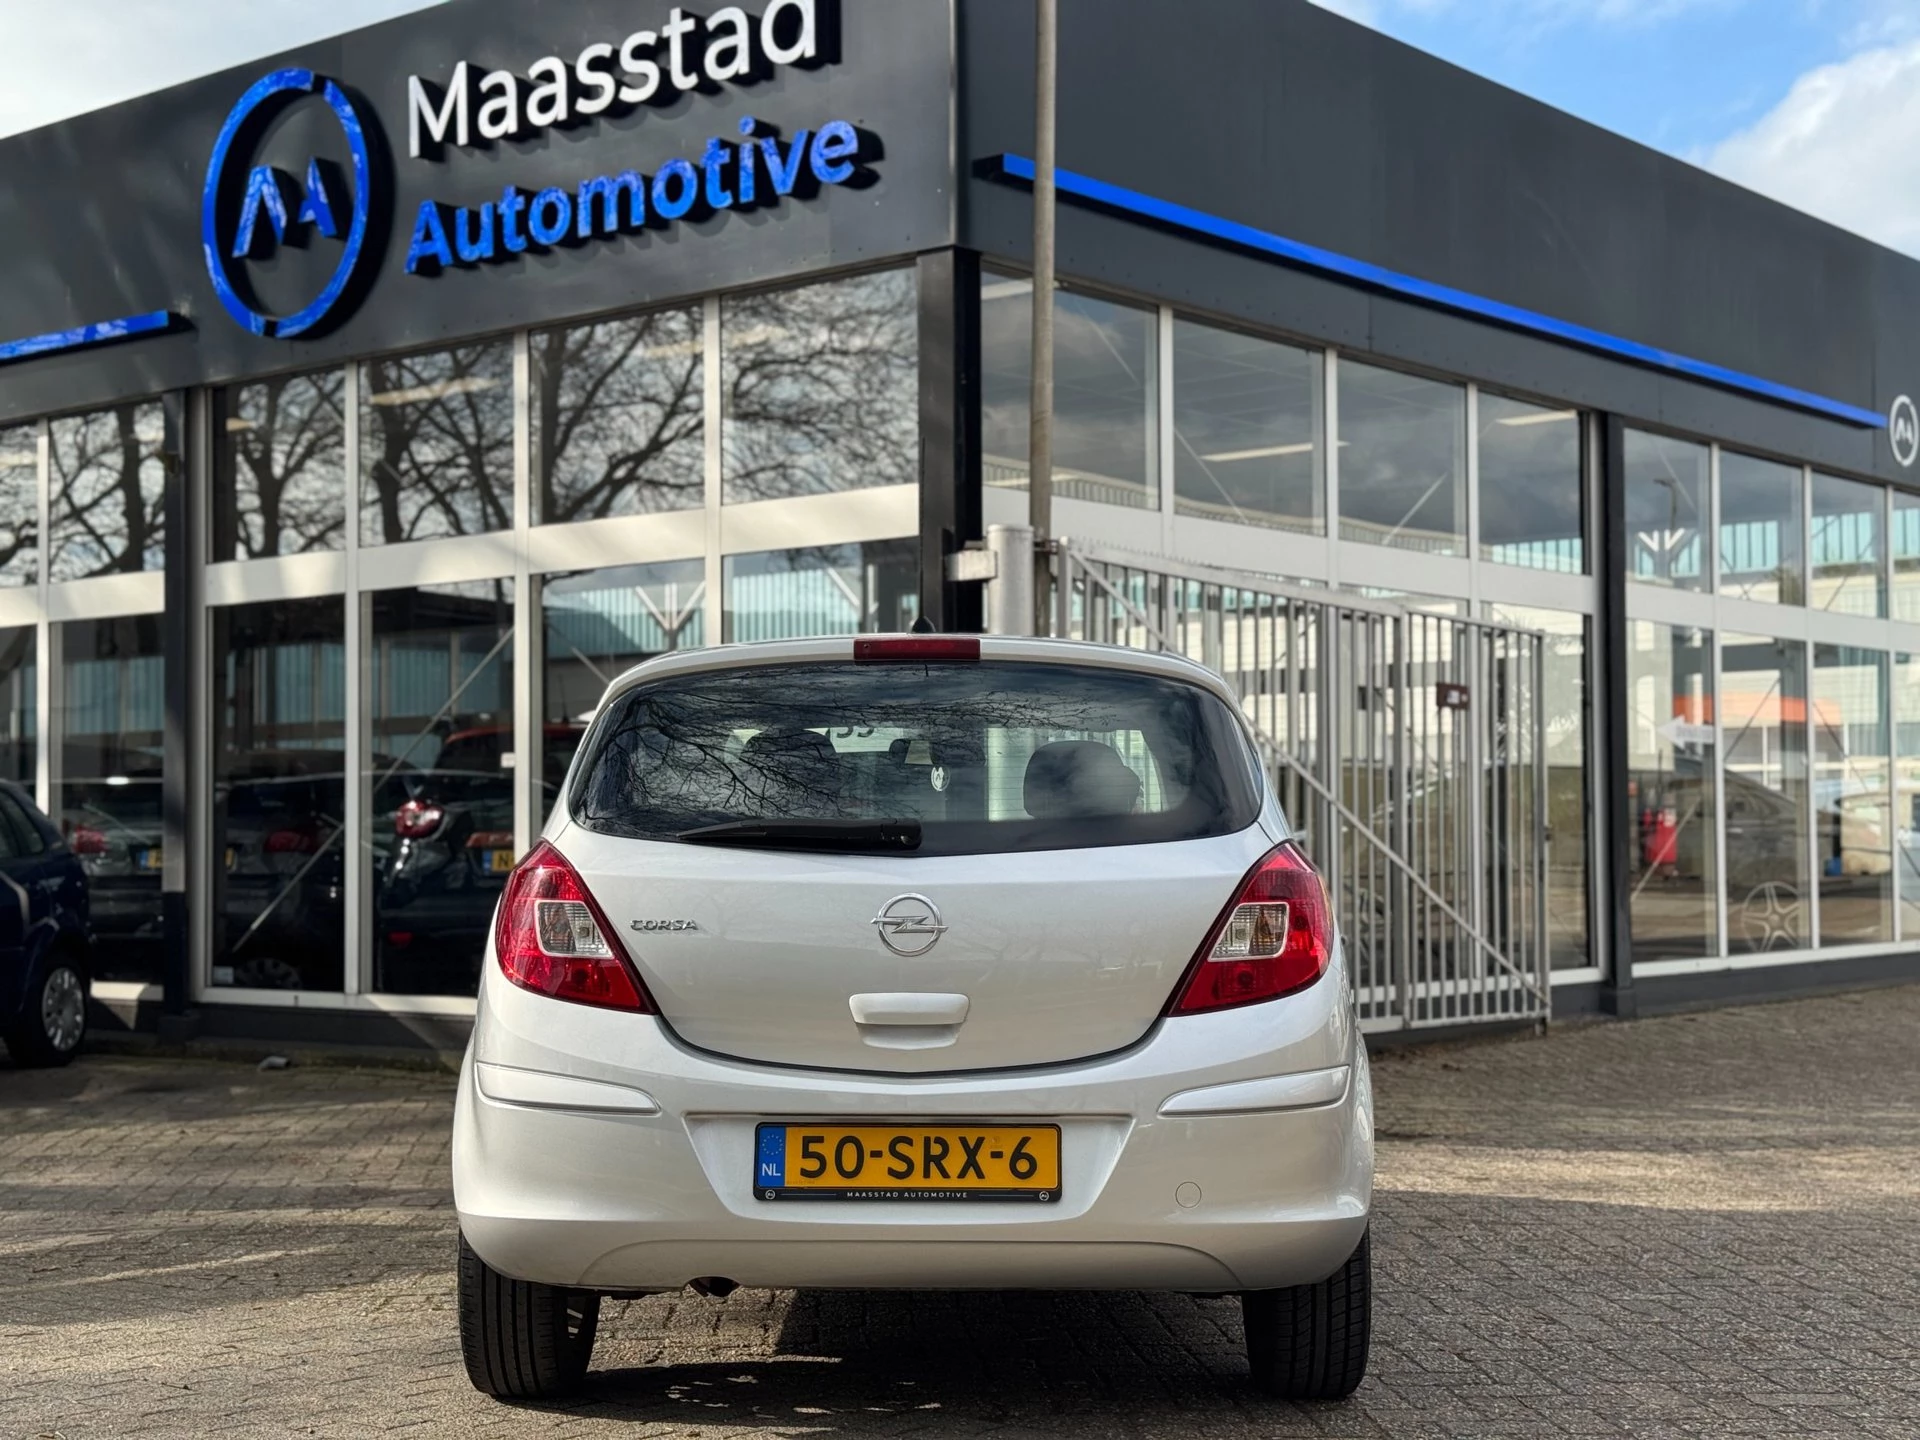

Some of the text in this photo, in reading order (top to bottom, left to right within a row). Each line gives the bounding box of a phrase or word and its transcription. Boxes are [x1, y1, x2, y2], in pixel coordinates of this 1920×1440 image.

[407, 0, 817, 158] Maasstad
[404, 116, 859, 275] Automotive
[630, 919, 699, 931] CORSA
[761, 1163, 782, 1177] NL
[799, 1135, 1038, 1180] 50-SRX-6
